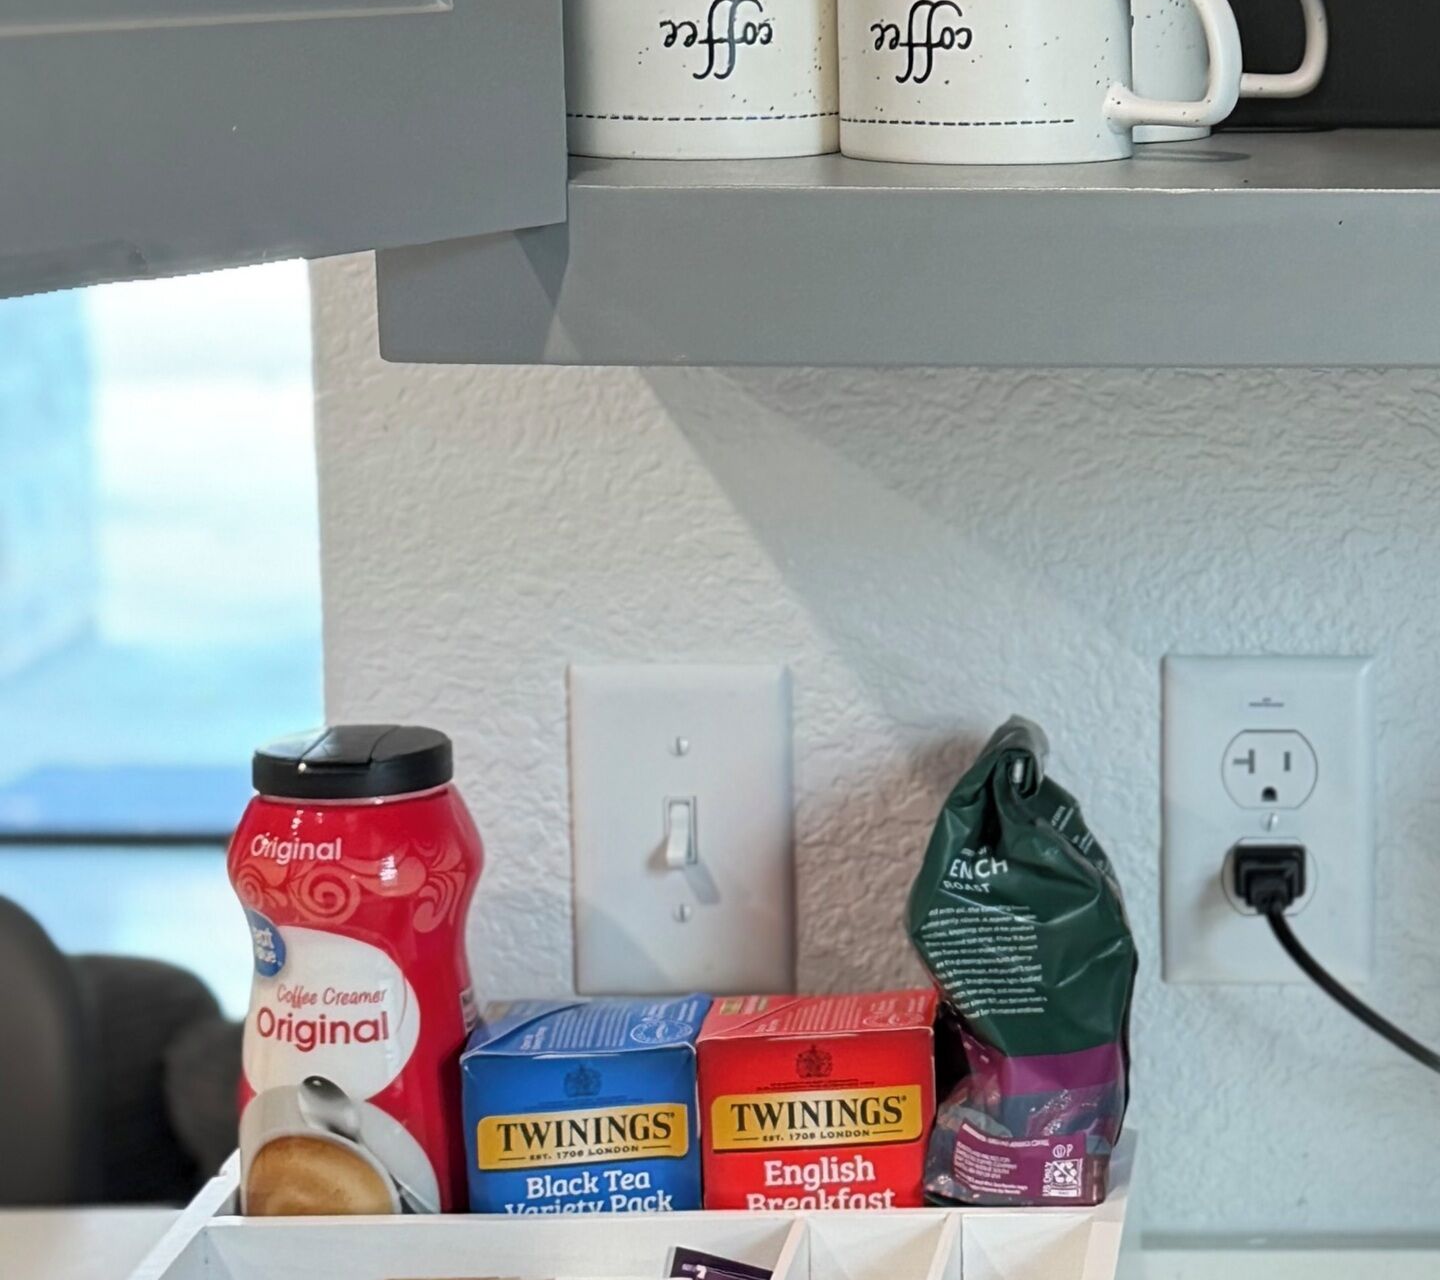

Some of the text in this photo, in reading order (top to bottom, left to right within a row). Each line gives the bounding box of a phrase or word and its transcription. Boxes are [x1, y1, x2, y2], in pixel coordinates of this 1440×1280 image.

[870, 0, 973, 84] coffee
[251, 833, 342, 865] Original
[949, 856, 1008, 880] ENCH
[943, 880, 990, 893] ROAST
[276, 984, 388, 1009] Coffee Creamer
[257, 1006, 390, 1052] Original
[731, 1095, 903, 1132] TWININGS
[497, 1111, 672, 1152] TWININGS
[820, 1129, 870, 1139] LONDON
[588, 1145, 639, 1156] LONDON
[526, 1169, 651, 1200] Black Tea
[763, 1154, 876, 1192] English
[609, 1189, 673, 1212] Pack
[746, 1187, 896, 1210] Breakfast
